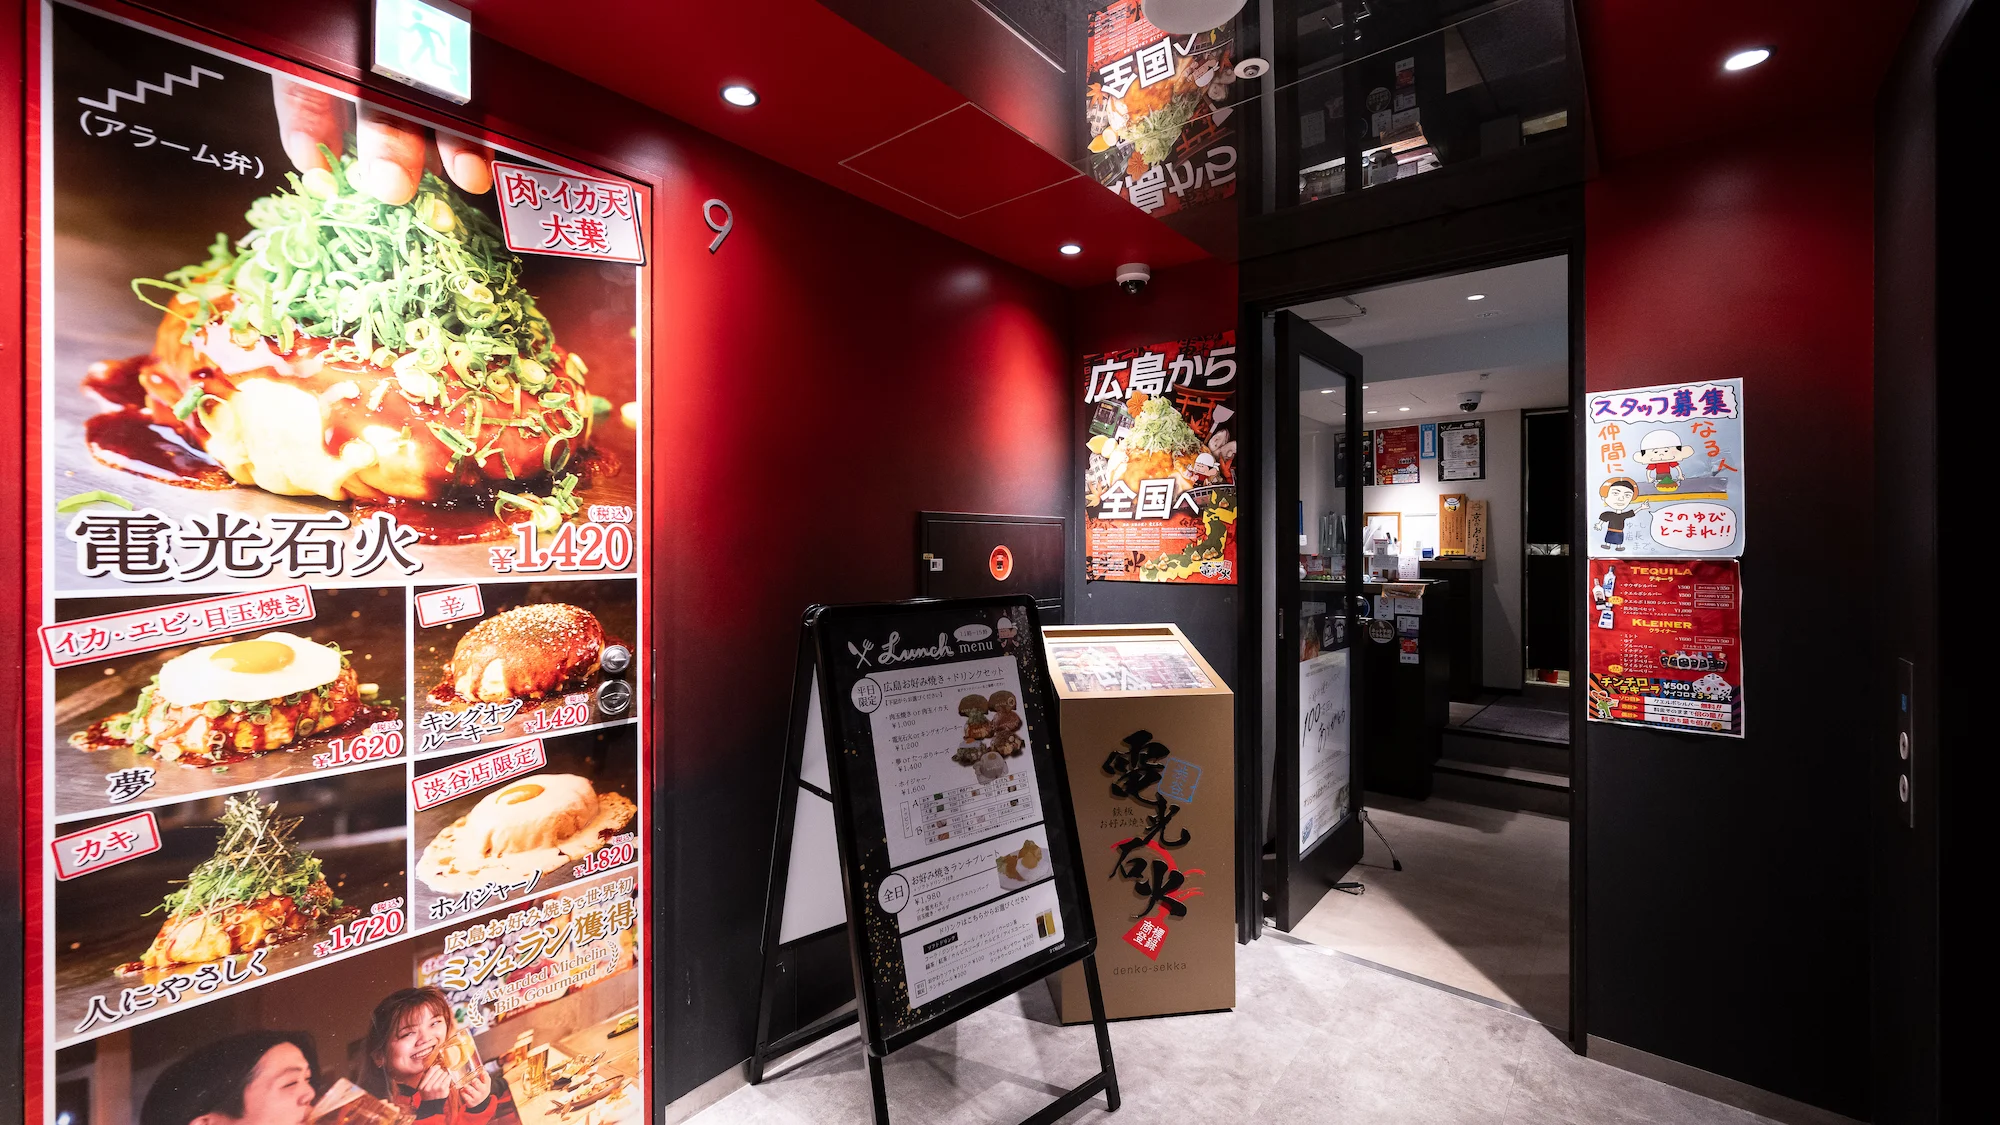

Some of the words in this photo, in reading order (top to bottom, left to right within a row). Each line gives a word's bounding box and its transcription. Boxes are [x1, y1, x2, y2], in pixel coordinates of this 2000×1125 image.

[79, 110, 265, 179] (アラーム弁)
[503, 172, 630, 219] 肉・イカ天
[541, 213, 608, 251] 大葉
[702, 197, 734, 252] 9
[1084, 345, 1237, 405] 広島から
[1594, 387, 1732, 417] スタッフ募集
[1597, 422, 1627, 474] 仲間に
[1690, 420, 1738, 473] なる人
[588, 505, 633, 523] (税込)
[1098, 478, 1200, 520] 全国へ
[1664, 511, 1727, 524] このゆび
[74, 512, 420, 578] 電光石火
[490, 524, 631, 571] ¥1,420
[1630, 566, 1693, 576] TEQUILA
[439, 595, 464, 616] 辛
[54, 593, 306, 657] イカ・エビ・目玉焼き
[1632, 618, 1692, 629] KLEINER
[877, 630, 955, 666] Lunch
[958, 640, 994, 654] menu
[856, 684, 876, 697] 平日
[1600, 676, 1649, 687] チンチロ
[1619, 685, 1661, 695] テキーラ
[1663, 681, 1691, 691] ¥500
[421, 699, 524, 734] キングオブ
[523, 704, 590, 734] ¥1,420
[858, 695, 878, 708] 限定
[420, 721, 505, 752] ルーキー
[892, 719, 917, 729] ¥1,000
[312, 732, 403, 768] ¥1,620
[895, 741, 920, 751] ¥1,200
[107, 767, 155, 802] 夢
[422, 746, 538, 801] 渋谷店限定
[897, 762, 923, 773] ¥1,400
[912, 799, 920, 809] A
[1112, 806, 1134, 817] 鉄板
[1099, 817, 1146, 829] お好み焼き
[72, 830, 138, 867] カキ
[573, 843, 635, 879] ¥1,820
[429, 869, 544, 920] ホイジャーノ
[882, 885, 905, 904] 全日
[914, 890, 942, 906] ¥1,980
[443, 876, 635, 955] 広島お好み焼きで世界初
[313, 909, 404, 958] ¥1,720
[442, 900, 637, 991] ミシュラン獲得
[480, 969, 549, 1006] Awarded
[550, 946, 608, 979] Michelin
[1112, 961, 1188, 976] denko-sekka
[74, 949, 269, 1034] 人にやさしく
[494, 996, 521, 1017] Bib
[523, 963, 597, 1002] Gourmand
